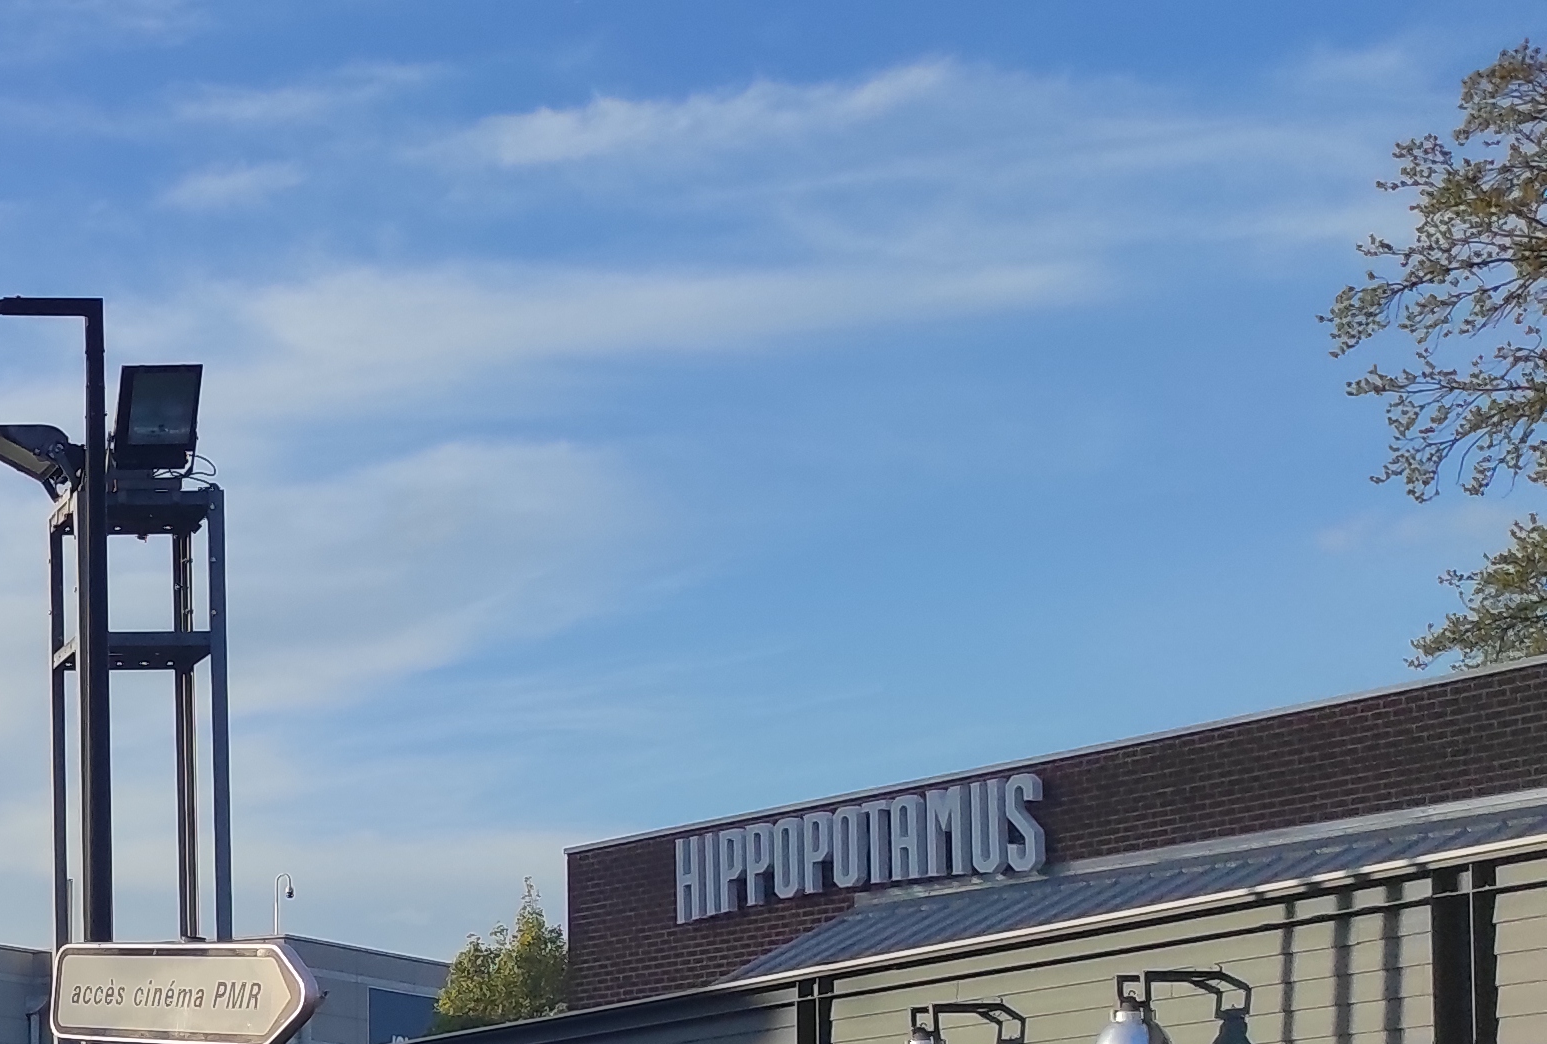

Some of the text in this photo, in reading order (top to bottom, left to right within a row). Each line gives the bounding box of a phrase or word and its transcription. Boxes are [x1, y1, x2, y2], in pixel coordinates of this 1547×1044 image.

[674, 772, 1047, 925] HIPPOPOTAMUS
[71, 978, 262, 1011] accès cinéma PMR
